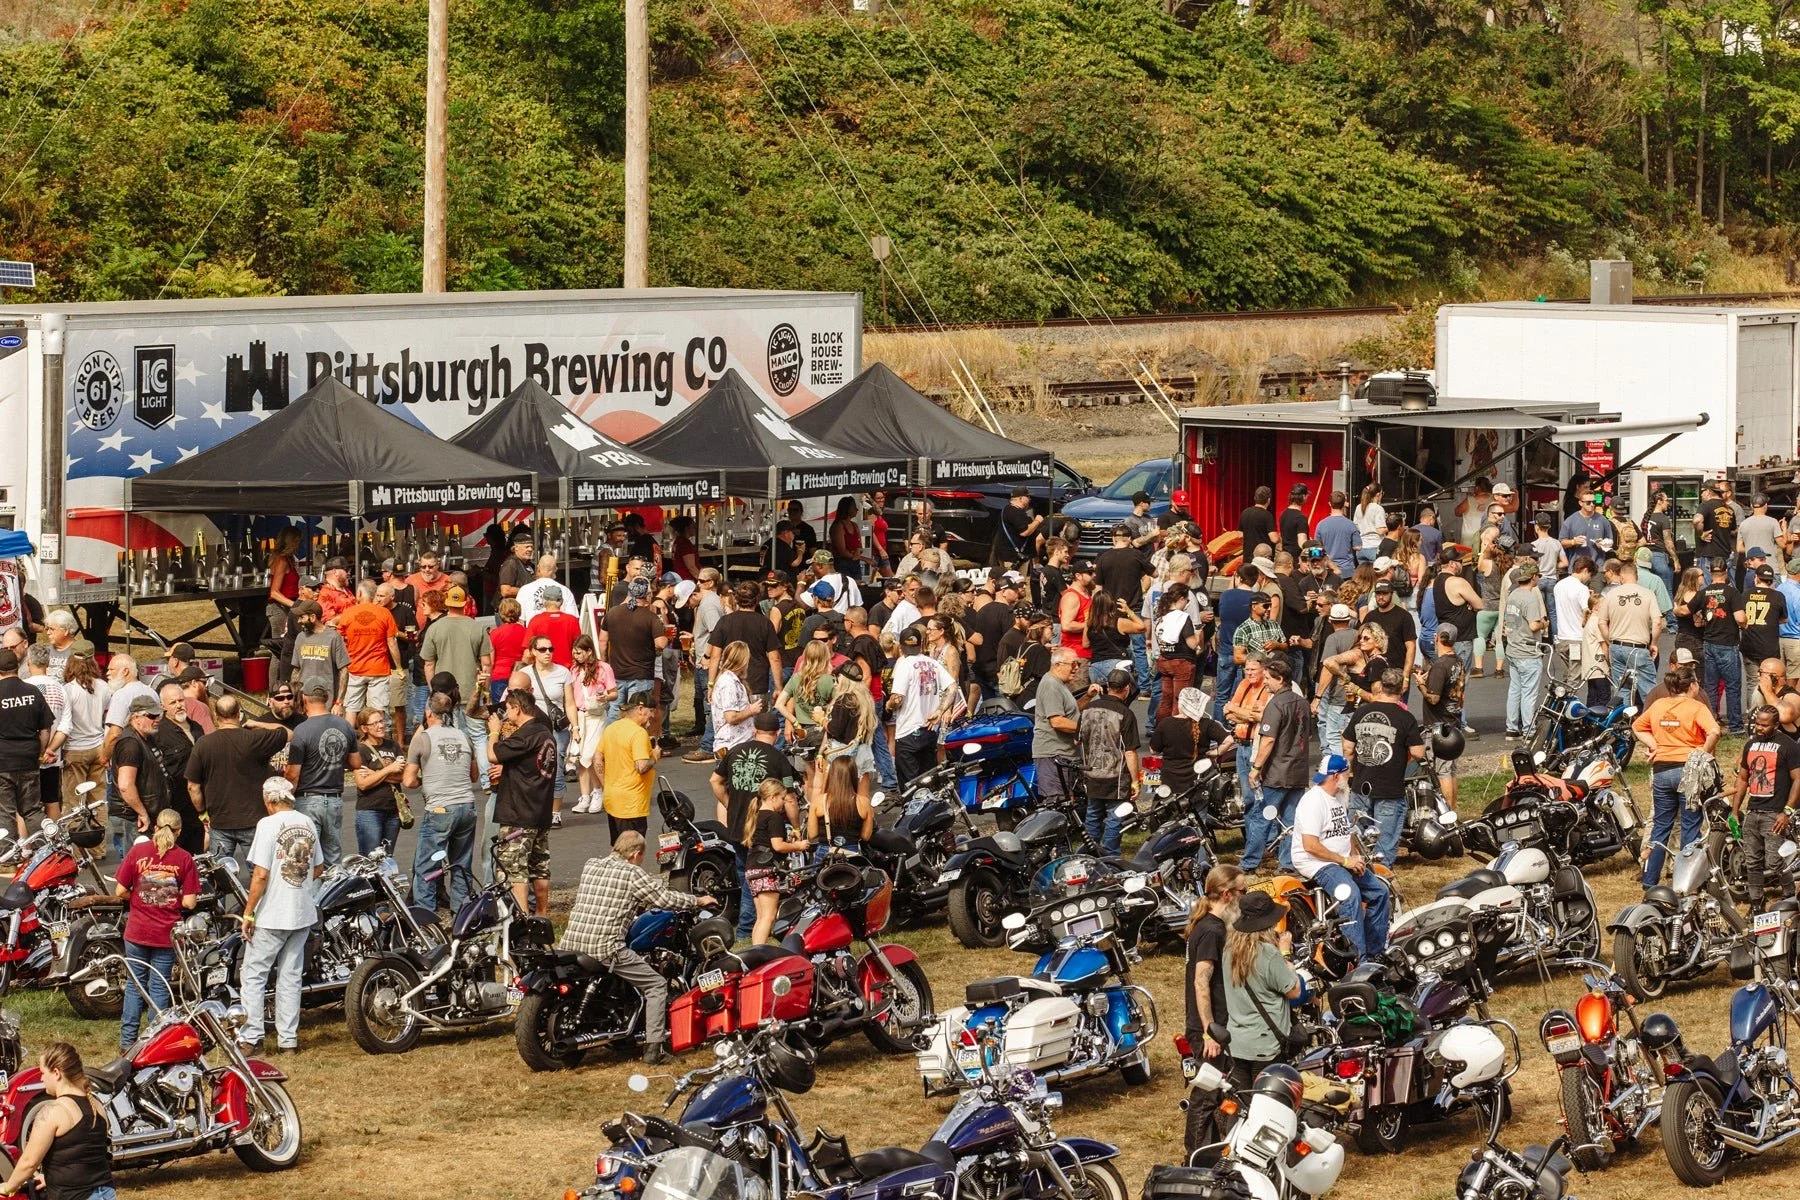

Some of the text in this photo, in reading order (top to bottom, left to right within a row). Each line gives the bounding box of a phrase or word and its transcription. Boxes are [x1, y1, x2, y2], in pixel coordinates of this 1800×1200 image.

[777, 330, 795, 345] LIGHT
[811, 332, 843, 344] BLOCK
[770, 351, 798, 369] MANGO
[811, 346, 843, 358] HOUSE
[76, 354, 122, 393] IRON CITY
[810, 359, 842, 371] BREW-
[141, 358, 168, 394] IC
[306, 344, 512, 415] Pittsburgh
[524, 339, 675, 406] Brewing
[810, 373, 827, 385] ING
[89, 380, 107, 401] 61
[141, 396, 168, 409] LIGHT
[82, 406, 115, 427] BEER
[802, 470, 849, 490] Pittsburgh
[850, 469, 885, 488] Brewing
[952, 461, 997, 480] Pittsburgh
[997, 460, 1031, 478] Brewing
[394, 484, 455, 506] Pittsburgh
[457, 482, 504, 503] Brewing
[597, 481, 651, 503] Pittsburgh
[652, 481, 694, 500] Brewing
[1749, 593, 1767, 601] CROSBY
[1745, 601, 1771, 626] 87
[1, 695, 35, 710] STAFF
